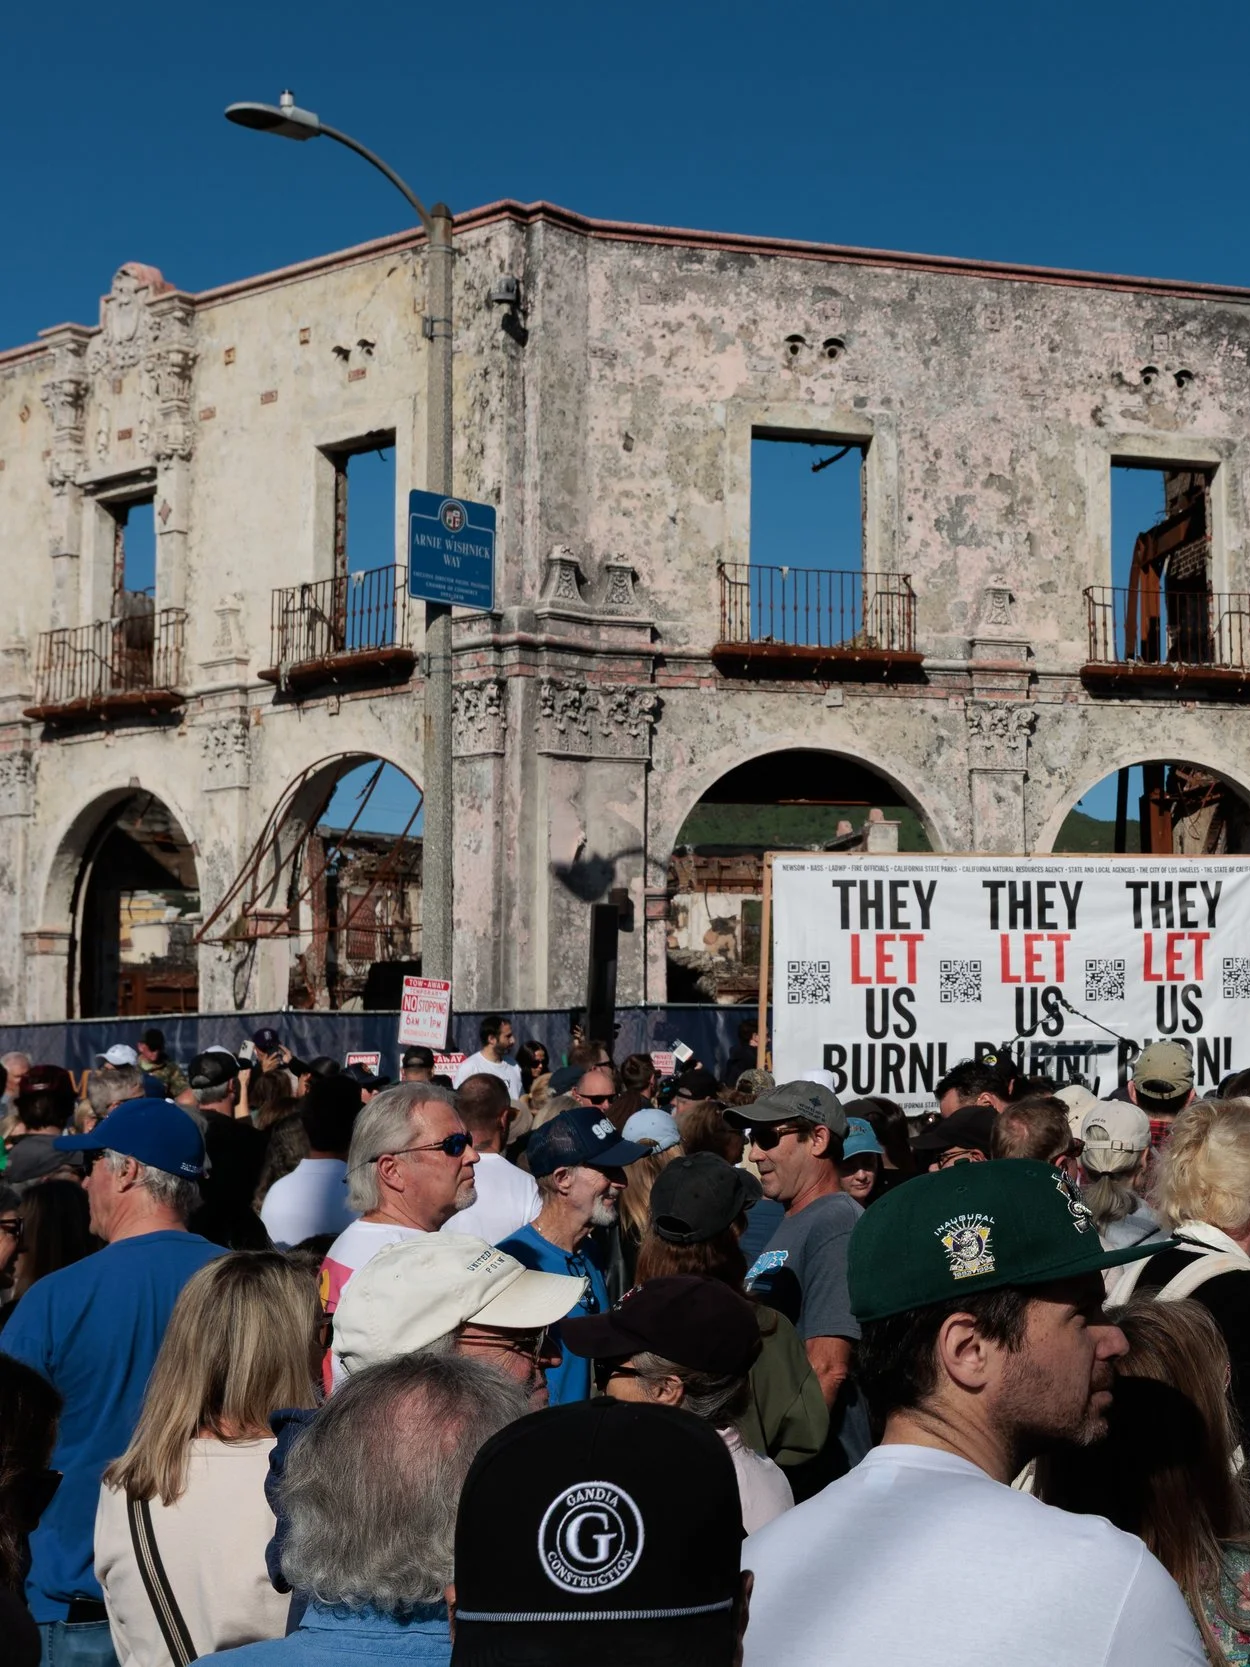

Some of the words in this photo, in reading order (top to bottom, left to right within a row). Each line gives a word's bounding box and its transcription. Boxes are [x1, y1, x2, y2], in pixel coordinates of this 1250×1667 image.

[413, 533, 442, 550] ARNIE
[444, 539, 491, 559] WISHNICK
[443, 553, 461, 568] WAY
[782, 864, 806, 872] NEWSOM
[810, 864, 824, 872] BASS
[828, 864, 847, 872] LADWP
[851, 864, 862, 872] FIRE
[863, 864, 889, 872] OFFICIALS
[893, 864, 924, 873] CALIFORNIA
[924, 864, 939, 873] STATE
[940, 864, 958, 873] PARKS
[962, 864, 991, 873] CALIFORNIA
[992, 864, 1015, 873] NATURAL
[1015, 866, 1044, 874] RESOURCES
[1044, 866, 1064, 874] AGENCY
[1068, 866, 1083, 874] STATE
[1084, 866, 1094, 874] AND
[1095, 866, 1111, 874] LOCAL
[1112, 866, 1135, 874] AGENCIES
[1139, 866, 1148, 874] THE
[1149, 866, 1160, 874] CITY
[1161, 866, 1167, 874] OF
[1168, 866, 1178, 874] LOS
[1179, 866, 1199, 874] ANGELES
[1204, 866, 1213, 874] THE
[1213, 866, 1228, 874] STATE
[1228, 866, 1234, 874] OF
[832, 879, 937, 930] THEY
[982, 880, 1083, 930] THEY
[1125, 880, 1222, 929] THEY
[850, 933, 925, 985] LET
[1000, 933, 1071, 984] LET
[1143, 931, 1211, 982] LET
[404, 995, 417, 1011] NO
[418, 1000, 447, 1015] STOPPING
[865, 986, 917, 1040] US
[1015, 986, 1065, 1037] US
[1156, 983, 1204, 1035] US
[349, 1056, 376, 1064] DANGER
[823, 1041, 948, 1095] BURN!
[1118, 1036, 1232, 1089] BN!
[933, 1213, 995, 1236] INAUGURAL
[467, 1250, 492, 1272] UNITED
[566, 1487, 619, 1508] GANDIA
[565, 1511, 618, 1564] G
[547, 1549, 634, 1588] CONSTRUCTION
